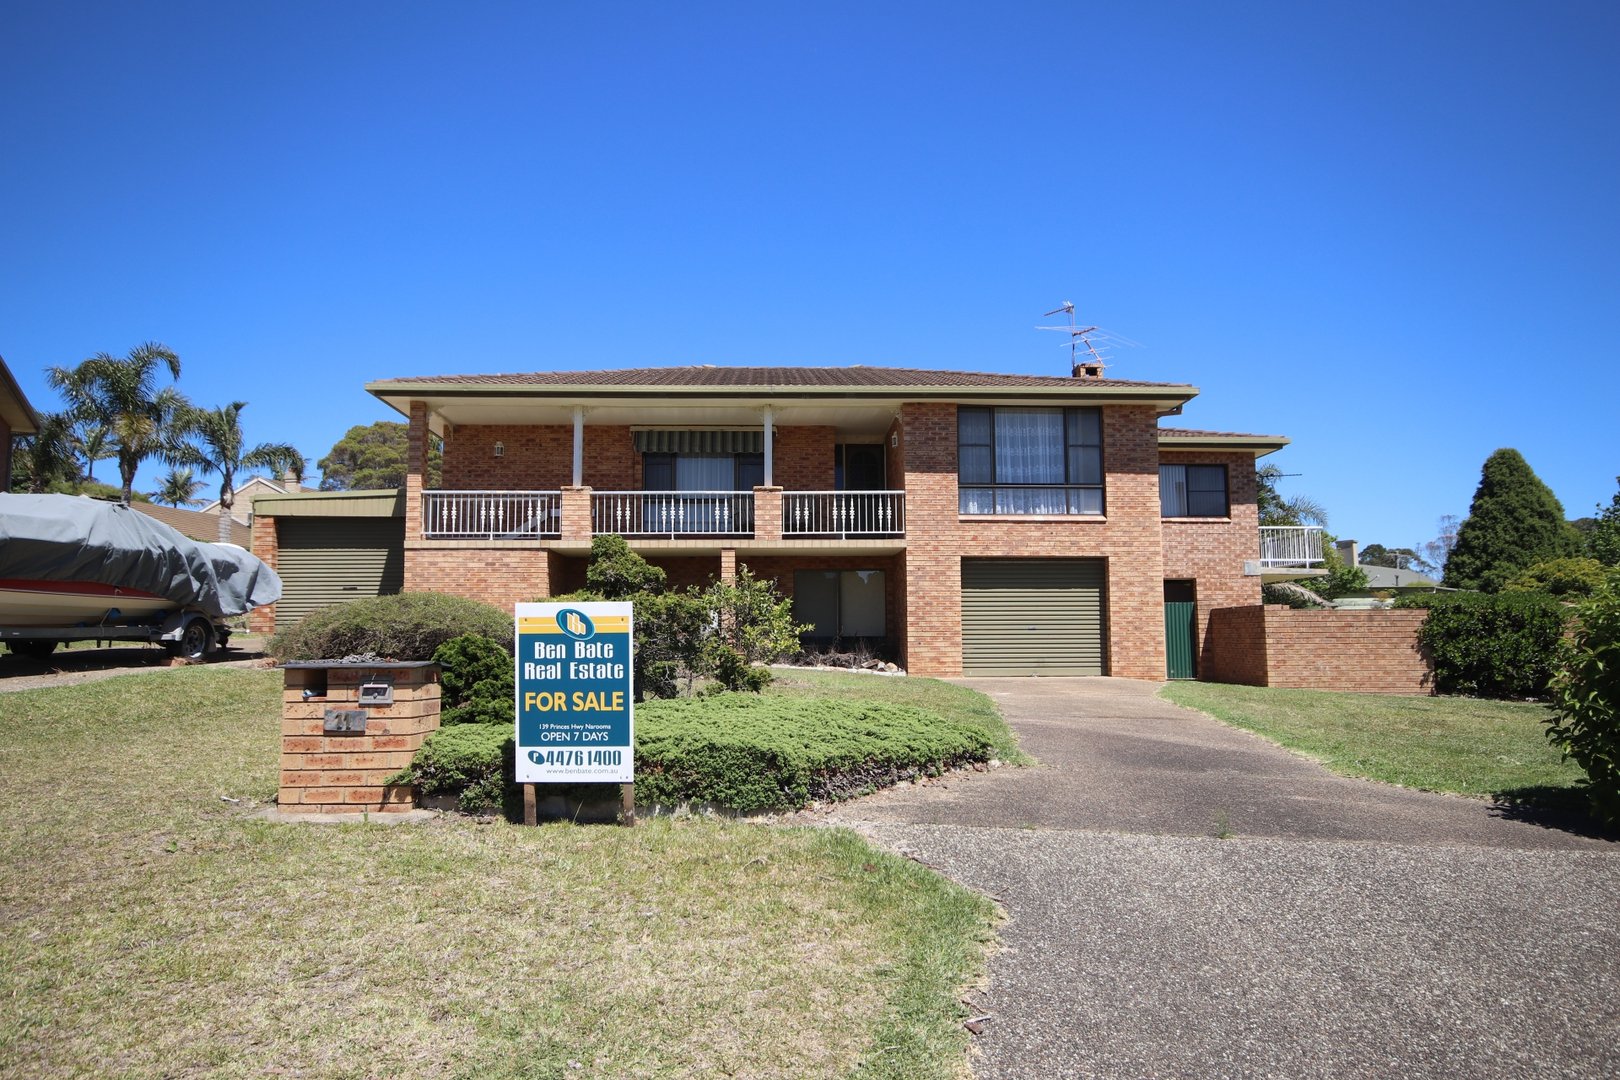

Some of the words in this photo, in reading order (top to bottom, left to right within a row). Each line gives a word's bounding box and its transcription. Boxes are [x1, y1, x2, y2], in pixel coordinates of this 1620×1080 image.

[534, 641, 566, 659] Ben
[575, 641, 614, 659] Bate
[524, 662, 561, 680] Real
[569, 662, 624, 680] Estate
[525, 691, 567, 711] FOR
[572, 691, 624, 711] SALE
[571, 723, 584, 731] Hwy
[540, 731, 571, 742] OPEN
[573, 731, 579, 742] 7
[582, 731, 609, 742] DAYS
[546, 750, 584, 766] 4476
[587, 750, 622, 766] 1400
